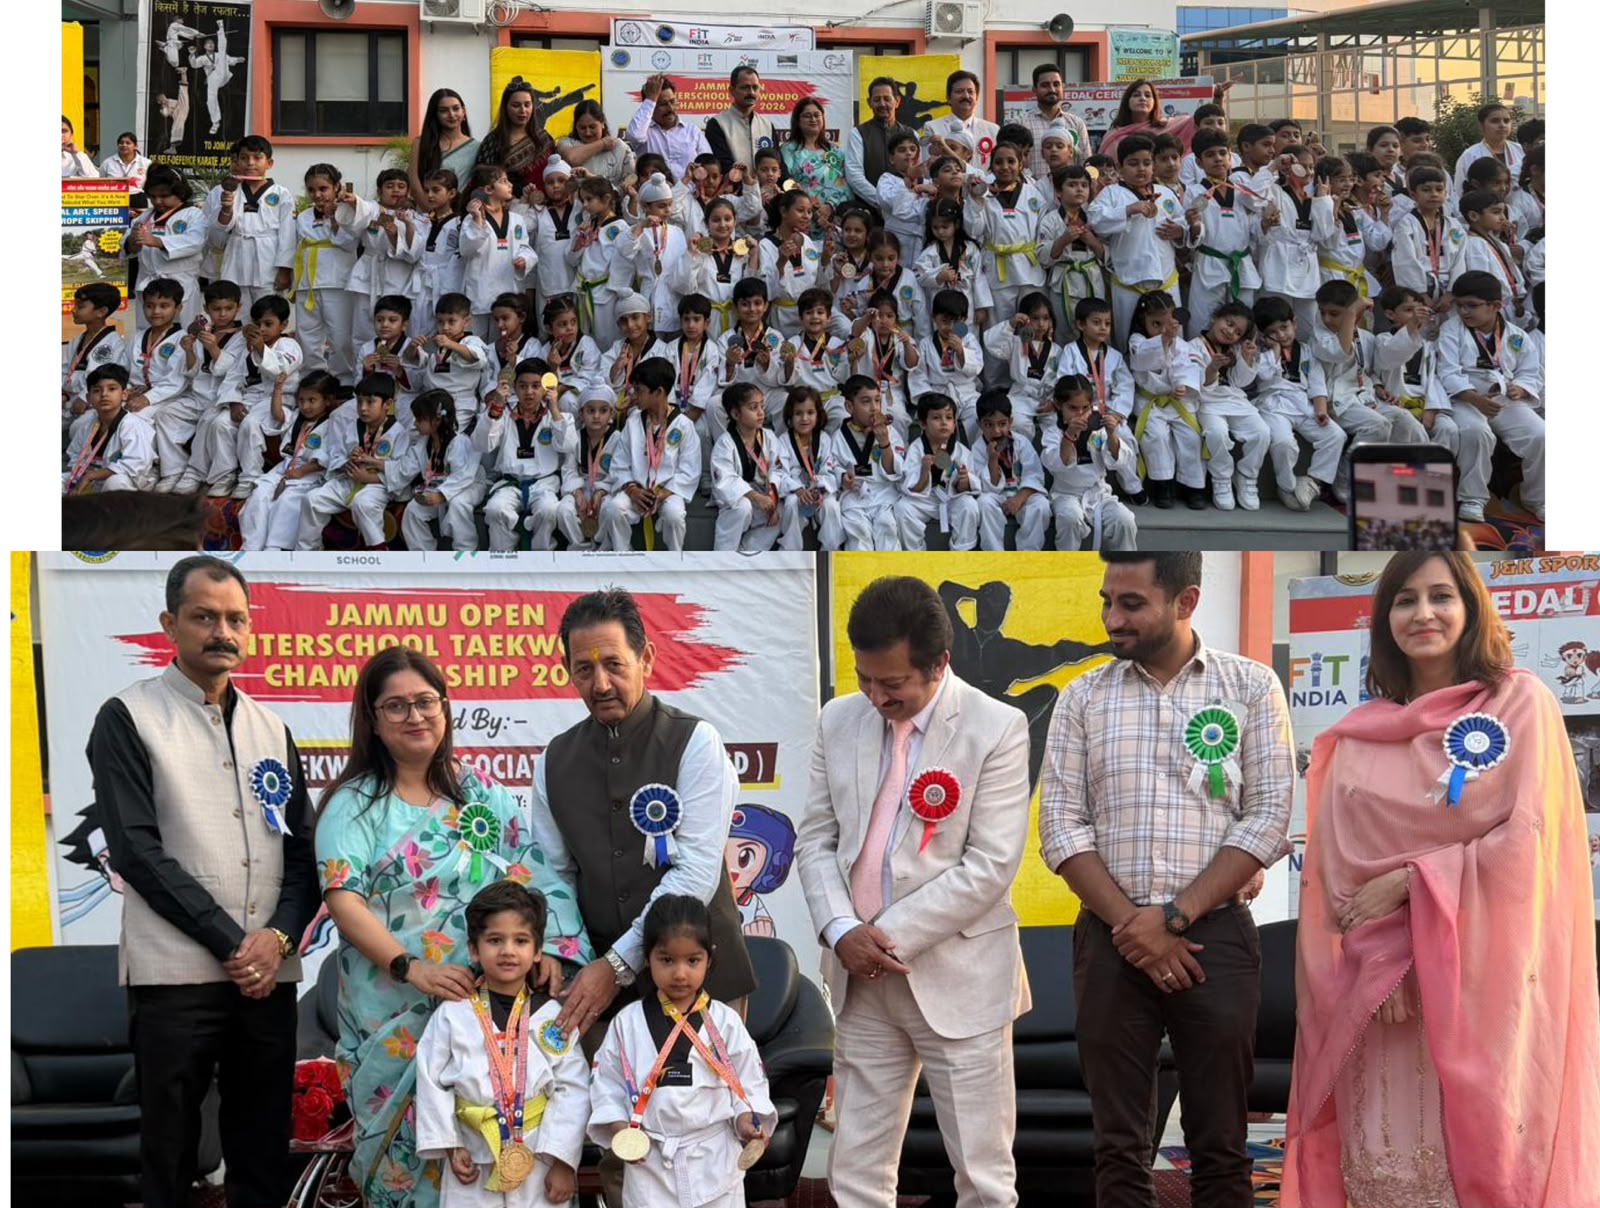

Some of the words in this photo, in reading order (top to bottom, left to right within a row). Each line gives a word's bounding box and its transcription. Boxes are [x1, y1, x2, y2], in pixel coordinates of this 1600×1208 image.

[694, 82, 730, 91] JAMM
[758, 93, 799, 101] WONDO
[1061, 90, 1091, 100] EDAL
[760, 102, 787, 111] 2026
[85, 216, 124, 224] SKIPPING
[336, 556, 381, 565] SCHOOL
[1490, 559, 1534, 579] J&K
[1538, 554, 1600, 574] SPOR
[1490, 587, 1585, 615] EDAL
[326, 603, 448, 627] JAMMU
[459, 603, 545, 627] OPEN
[247, 633, 440, 657] TERSCHOOL
[449, 633, 566, 657] TAEKW
[264, 663, 519, 687] CHAMSHIP
[531, 663, 570, 687] 20
[1292, 690, 1348, 707] NDIA
